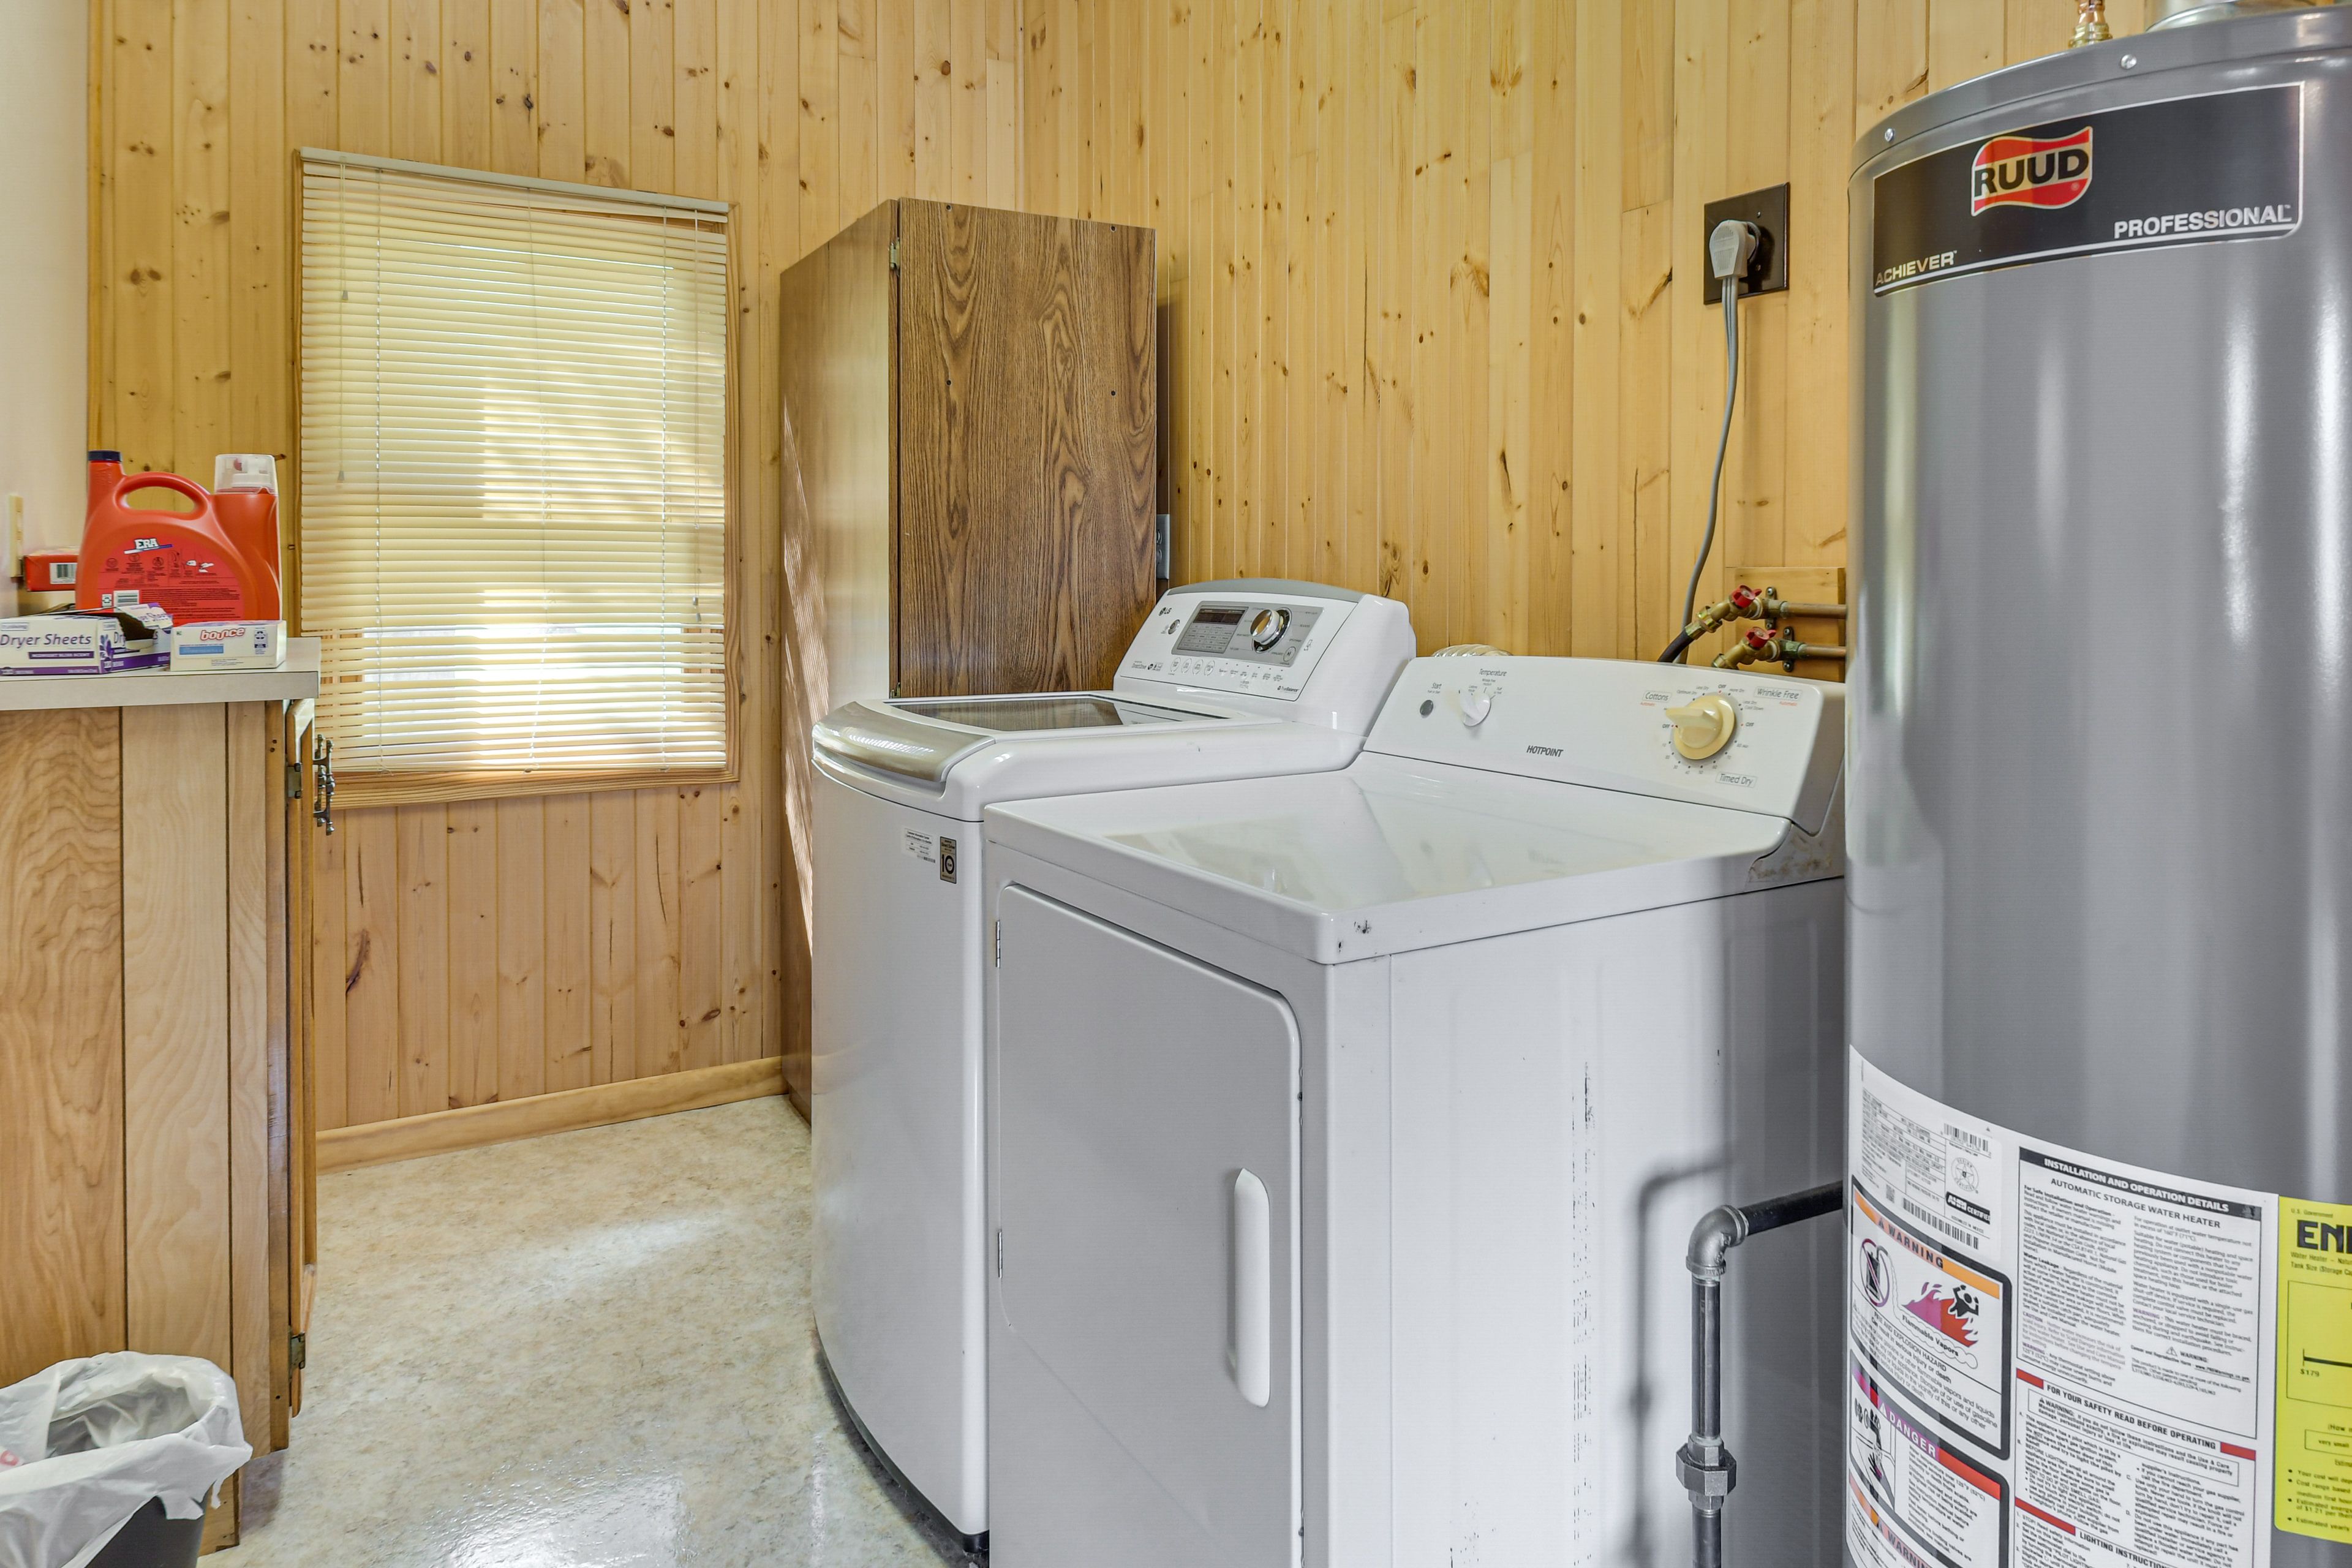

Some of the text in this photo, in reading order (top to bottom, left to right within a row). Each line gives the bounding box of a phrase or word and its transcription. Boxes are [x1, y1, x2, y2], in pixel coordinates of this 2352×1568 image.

[1974, 148, 2090, 197] RUUD
[2114, 205, 2292, 239] PROFESSIONAL
[1875, 252, 1954, 287] ACHIEVER
[134, 538, 158, 549] ERA
[0, 633, 91, 649] Dryer Sheets
[200, 627, 246, 641] bounce
[1479, 668, 1507, 677] Temperature
[1645, 692, 1668, 701] Cottons
[1757, 688, 1781, 698] Wrinkle
[1526, 745, 1564, 757] HOTPOINT
[1720, 774, 1753, 786] Timed Dry
[2044, 1158, 2228, 1212] INSTALLATION AND OPERATION DETAILS
[2051, 1178, 2220, 1228] AUTOMATIC STORAGE WATER HEATER
[1889, 1224, 1943, 1269] WARNING
[1893, 1328, 1921, 1353] EXPLOSION
[1922, 1350, 1946, 1371] HAZARD
[1902, 1315, 1959, 1357] Flammable Vapors
[2047, 1385, 2215, 1449] FOR YOUR SAFETY READ BEFORE OPERATING
[1890, 1411, 1936, 1458] DANGER
[1888, 1530, 1929, 1568] WARNI
[2079, 1532, 2113, 1551] LIGHTING
